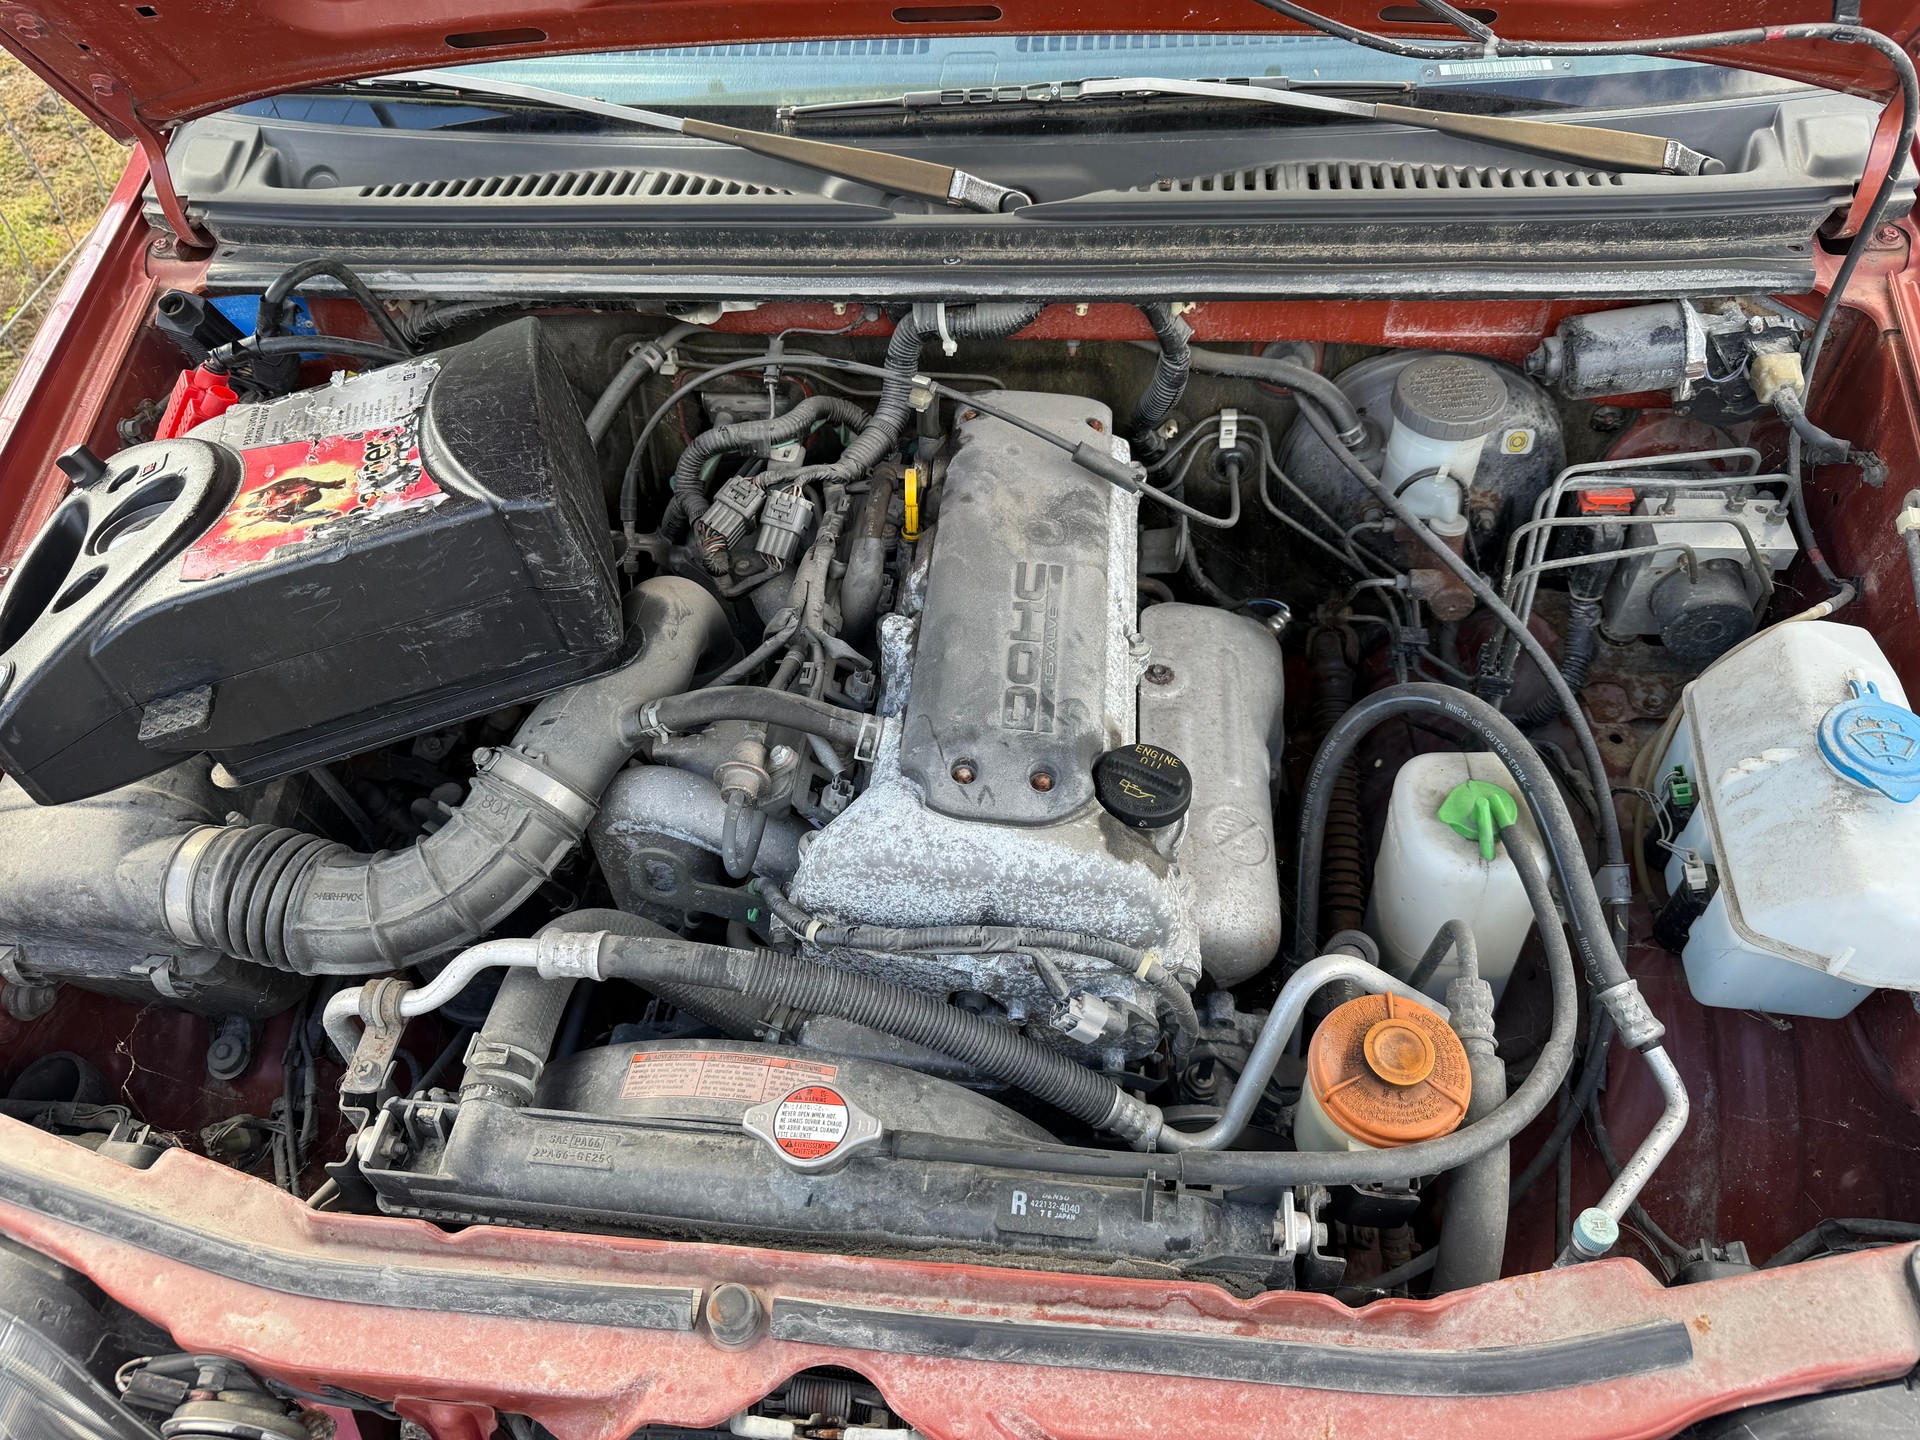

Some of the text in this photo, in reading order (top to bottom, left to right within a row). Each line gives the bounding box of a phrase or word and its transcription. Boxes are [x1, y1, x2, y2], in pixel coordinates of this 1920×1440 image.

[1045, 606, 1058, 659] VALVE
[1002, 561, 1047, 732] DOHC
[1135, 744, 1181, 768] ENGINE
[549, 1135, 569, 1144] SAE
[820, 1126, 840, 1134] CUANDO
[1011, 1190, 1028, 1216] R
[1030, 1200, 1080, 1214] 422132-4040
[1047, 1210, 1052, 1218] E
